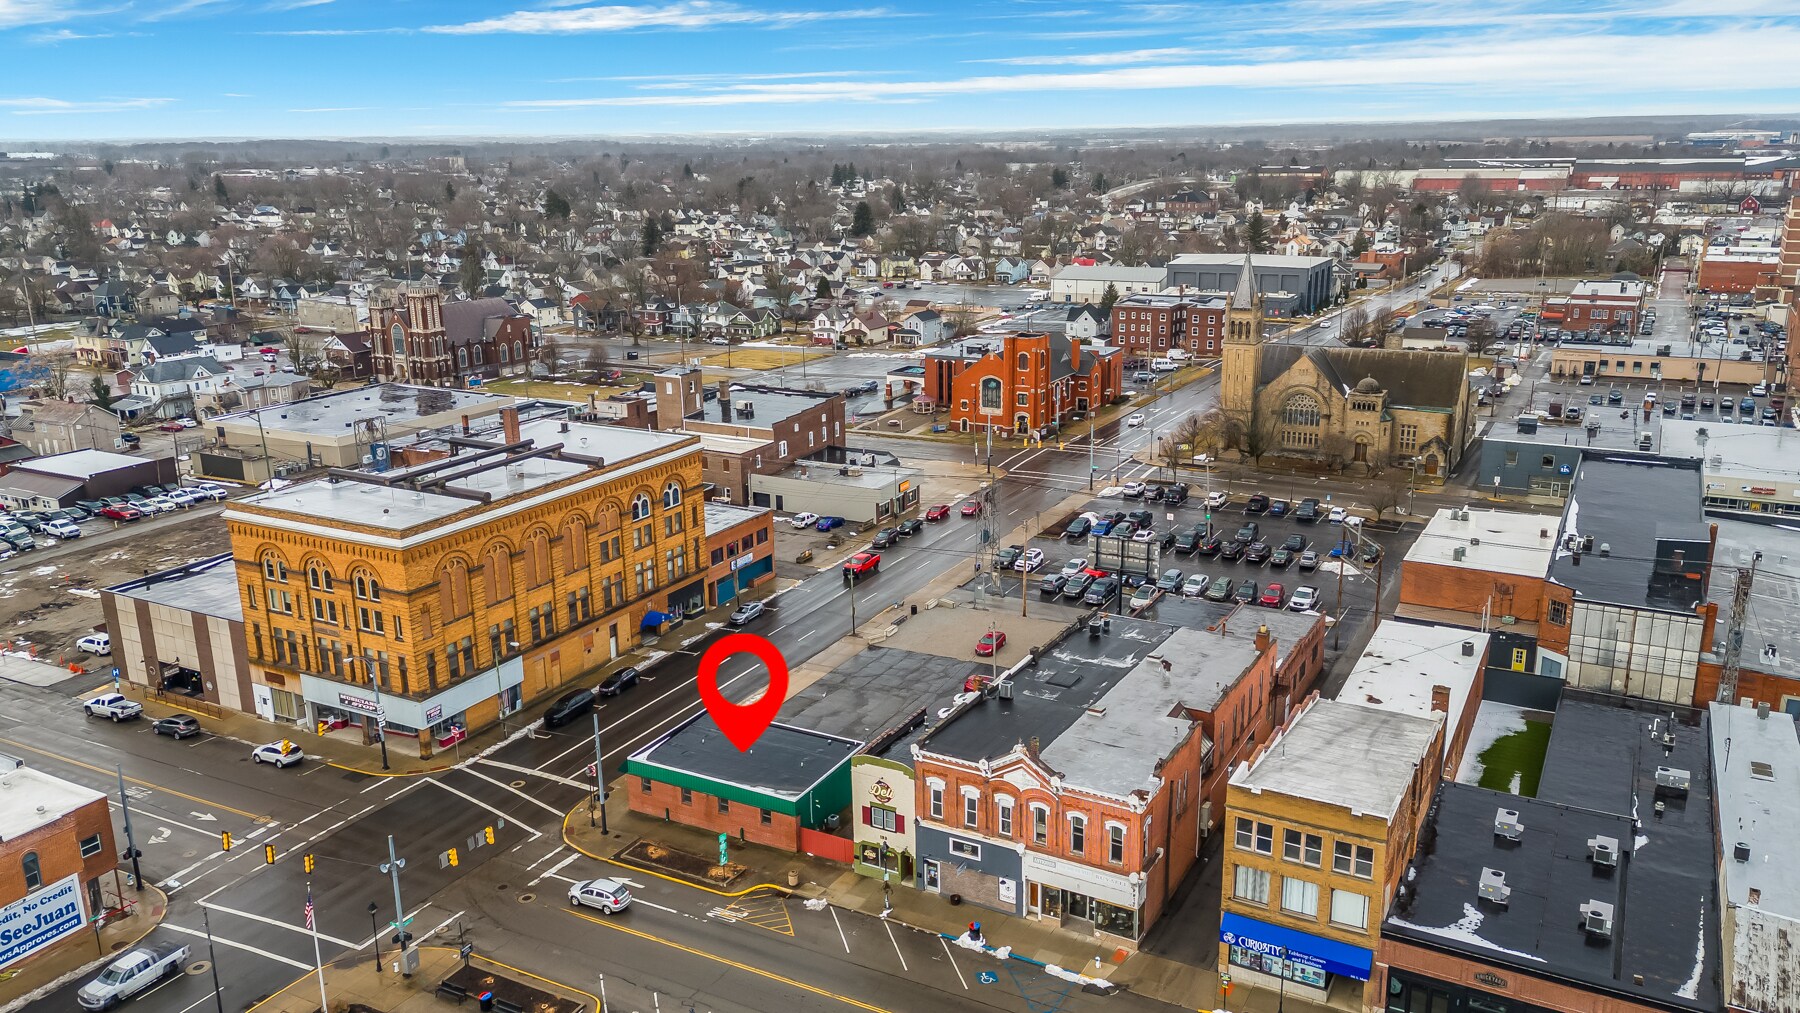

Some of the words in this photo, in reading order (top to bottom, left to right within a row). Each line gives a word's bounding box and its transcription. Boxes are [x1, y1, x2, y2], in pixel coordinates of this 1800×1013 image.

[868, 783, 894, 799] Deli
[23, 904, 38, 914] No
[40, 886, 73, 905] Credit
[0, 901, 77, 946] SeeJuan
[1238, 936, 1283, 956] CURIOSITY
